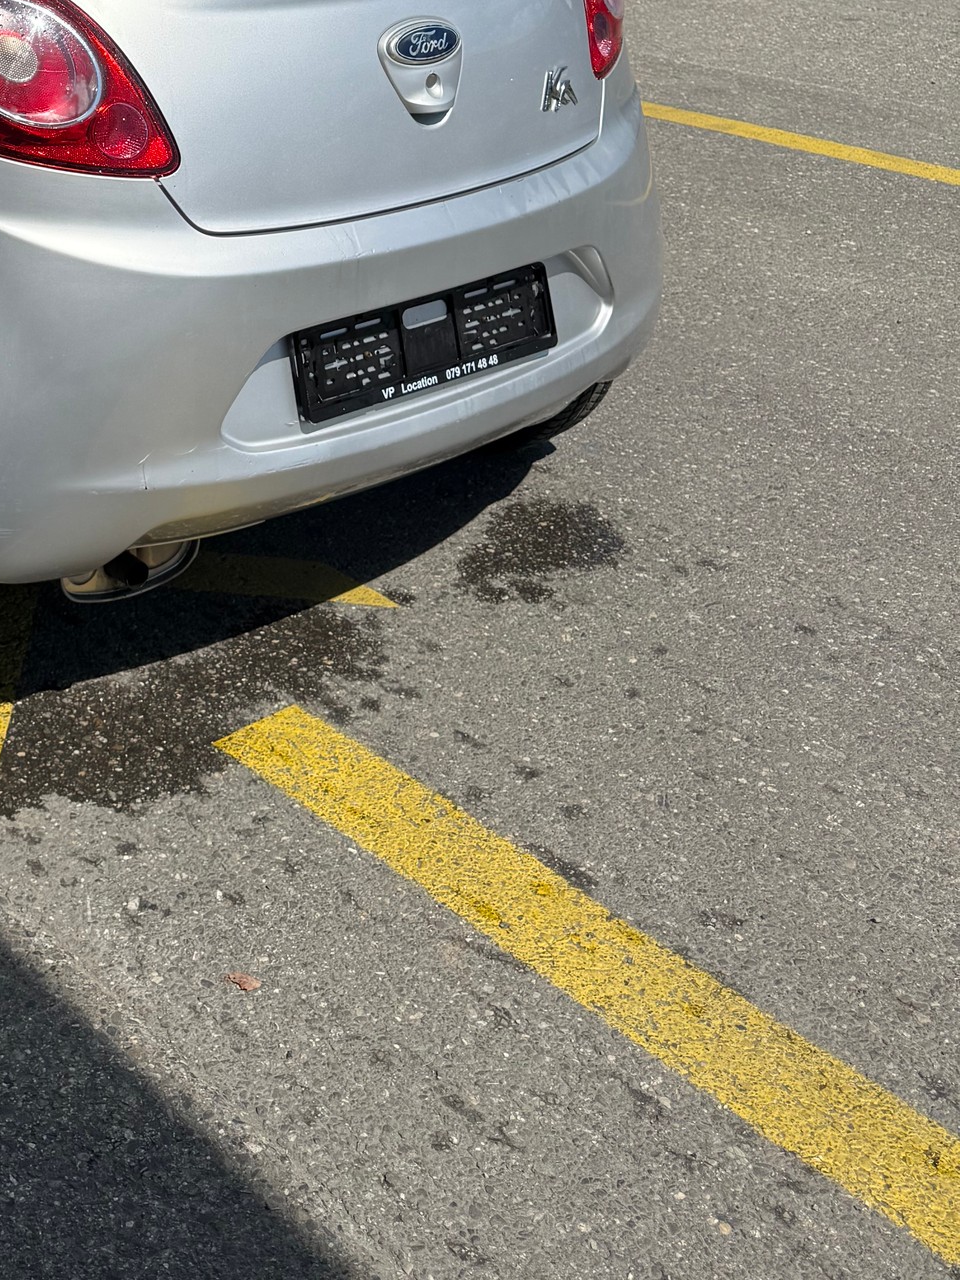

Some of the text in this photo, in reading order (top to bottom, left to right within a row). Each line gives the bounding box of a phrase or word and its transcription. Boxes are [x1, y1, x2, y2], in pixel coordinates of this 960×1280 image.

[409, 29, 449, 56] Ford
[382, 354, 499, 400] VP Location 079 171 48 48
